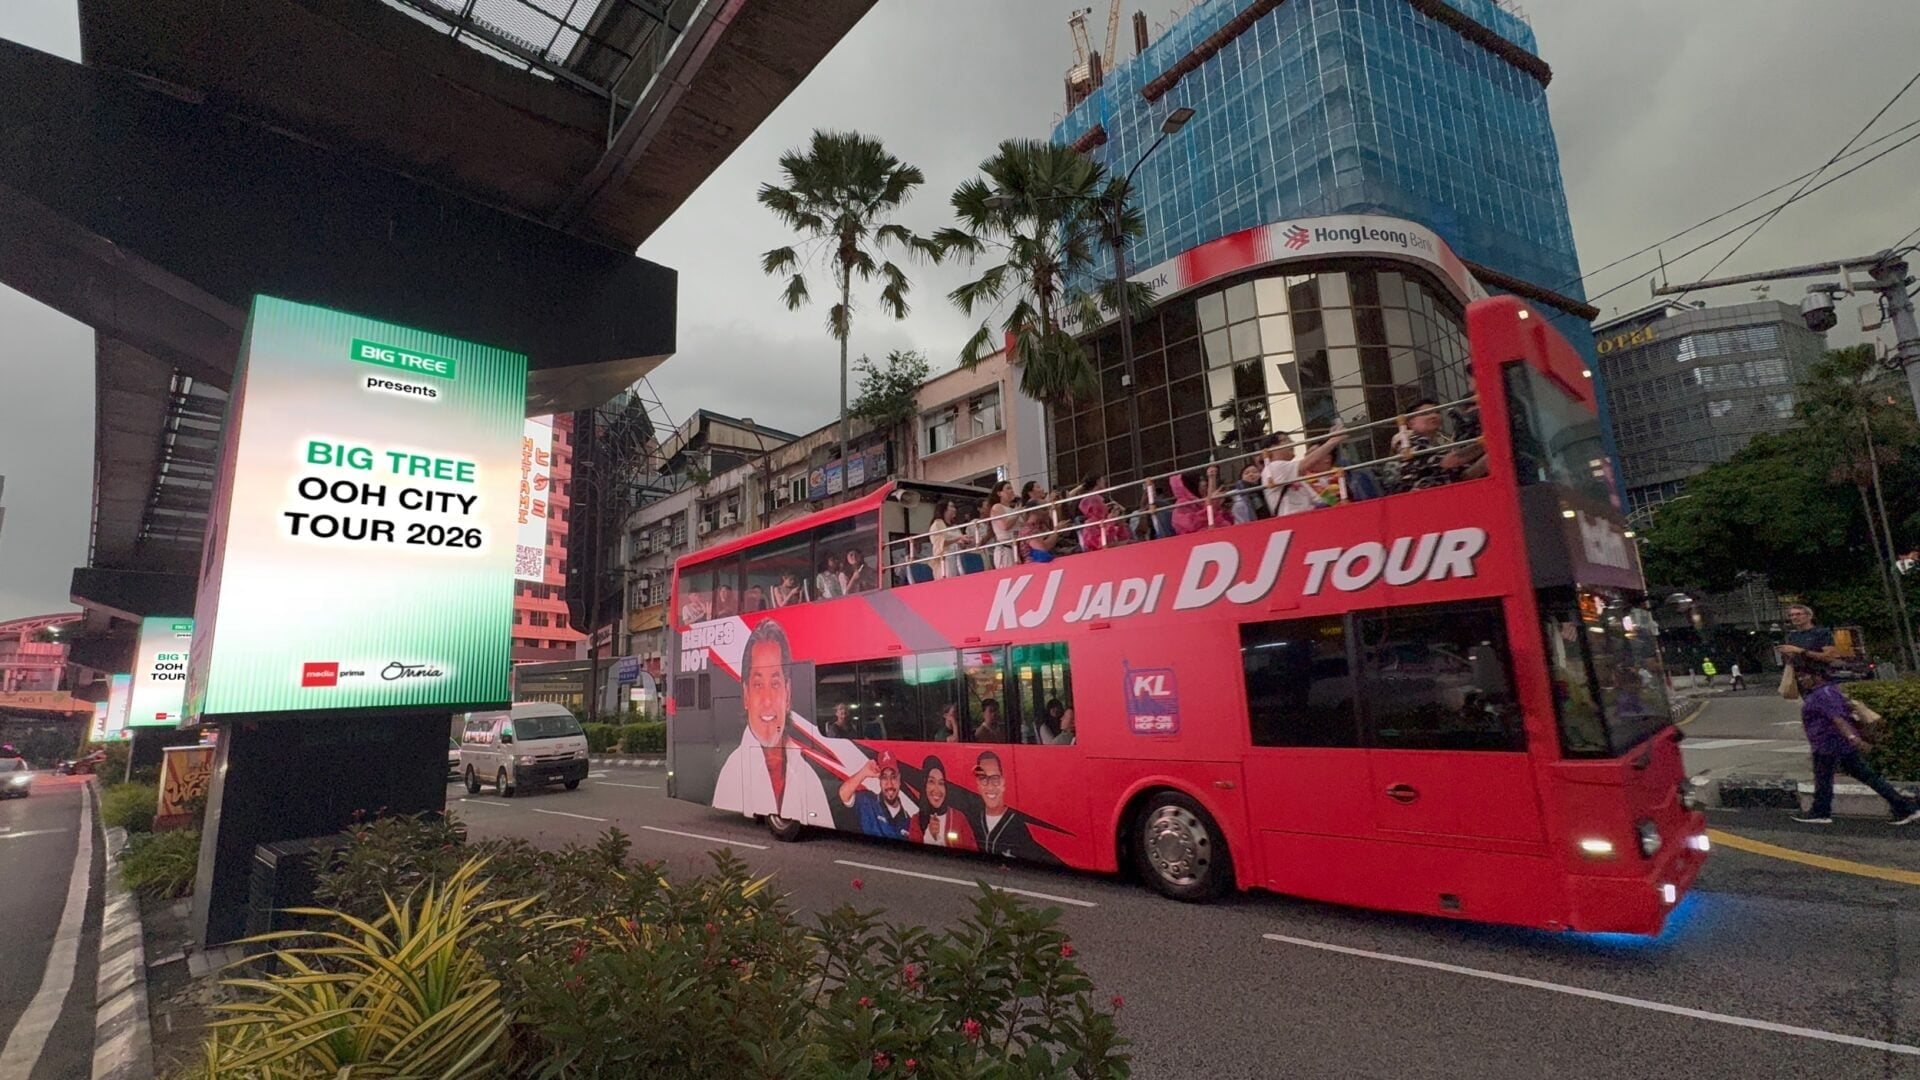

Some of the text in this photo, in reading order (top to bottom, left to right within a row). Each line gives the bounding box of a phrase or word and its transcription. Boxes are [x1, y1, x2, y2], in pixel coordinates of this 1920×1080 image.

[1410, 231, 1433, 251] Bank
[1597, 325, 1653, 353] OTEL
[361, 344, 448, 374] BIG TREE
[367, 377, 437, 398] presents
[307, 441, 476, 483] BIG TREE
[518, 436, 534, 524] HITAMI
[298, 477, 478, 515] OOH CITY
[284, 511, 483, 549] TOUR 2026
[984, 527, 1487, 632] KJ JADI DJ TOUR
[155, 663, 183, 671] OOH
[157, 653, 179, 661] BIG
[681, 648, 709, 673] HOT
[151, 673, 186, 681] TOUR
[339, 670, 365, 678] prima
[1133, 675, 1171, 697] KL
